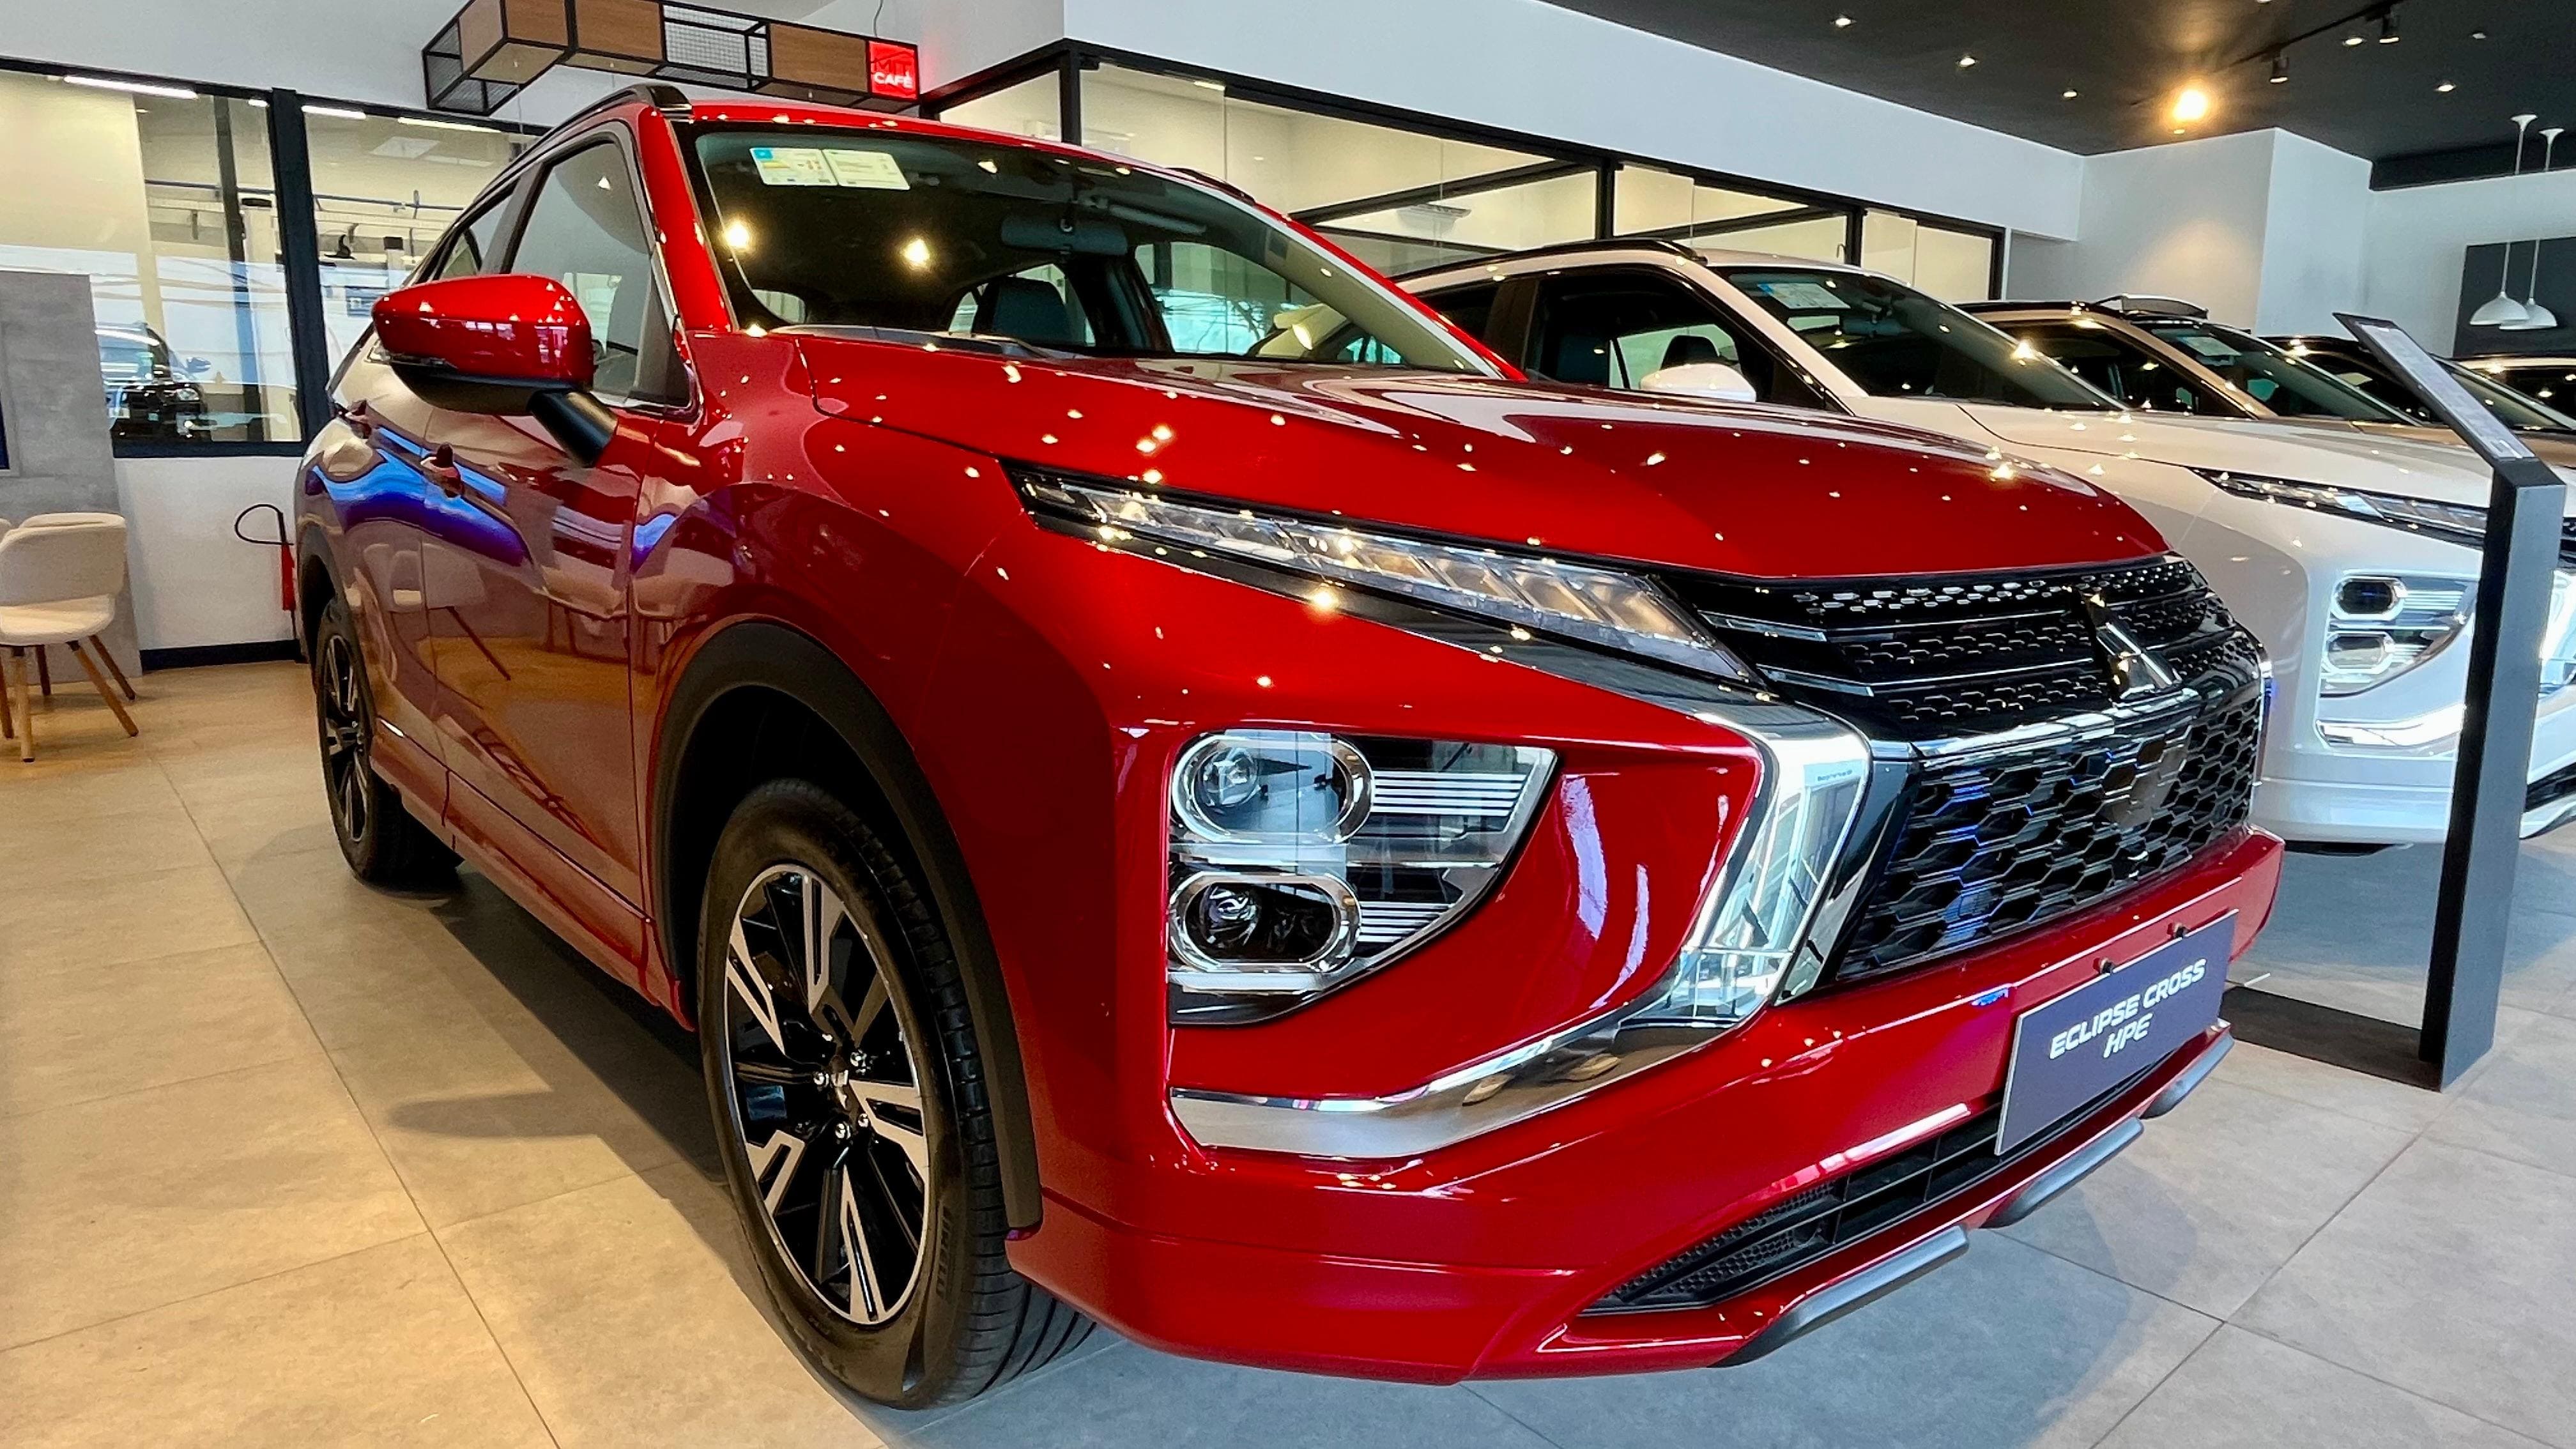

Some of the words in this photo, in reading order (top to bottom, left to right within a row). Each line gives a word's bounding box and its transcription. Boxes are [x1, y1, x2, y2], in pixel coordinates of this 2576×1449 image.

[873, 70, 914, 89] CAFÉ
[2049, 993, 2140, 1060] ECLIPSE
[2142, 958, 2207, 1009] CROSS
[2103, 1013, 2154, 1059] HPE
